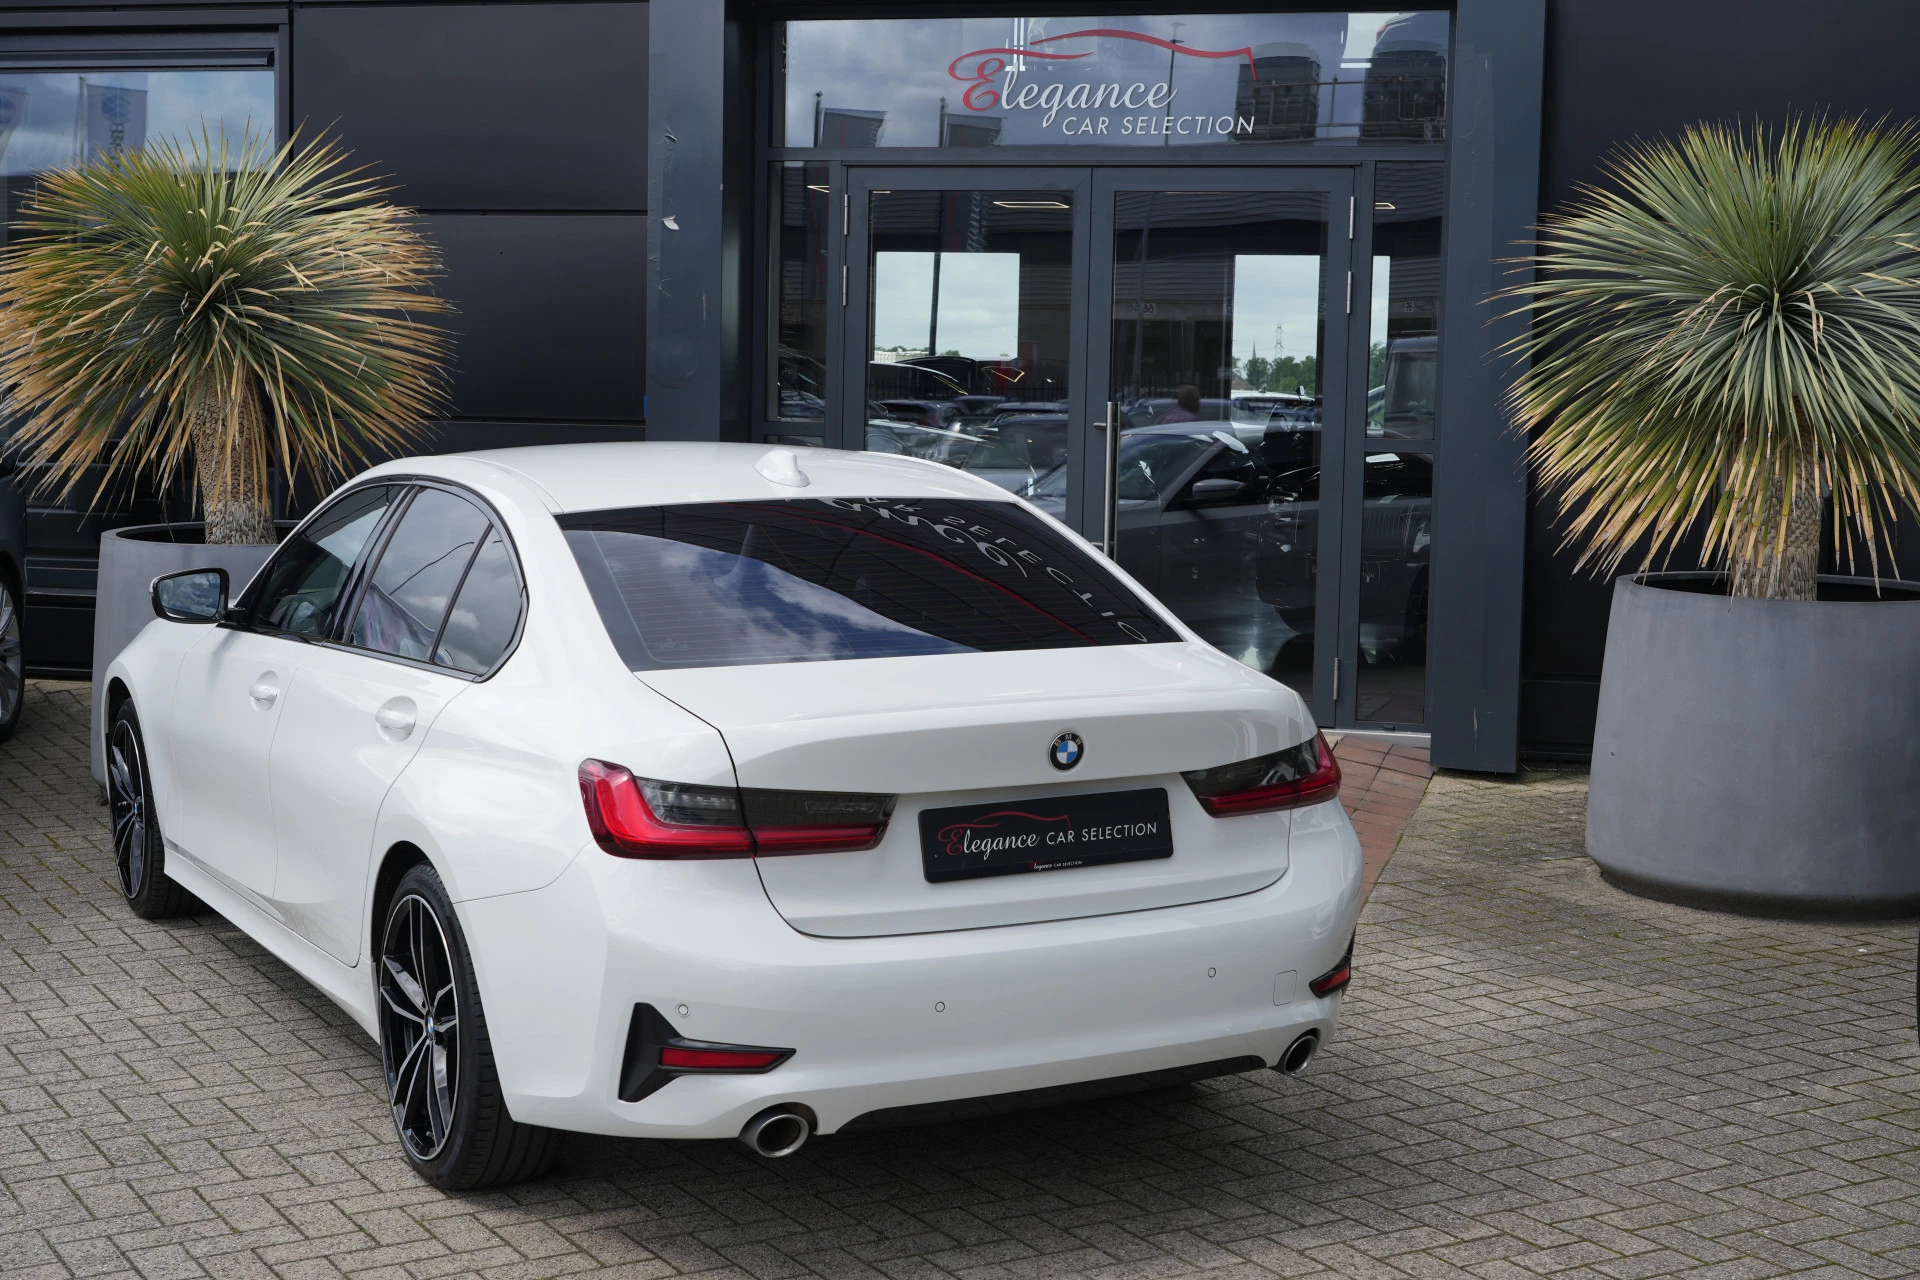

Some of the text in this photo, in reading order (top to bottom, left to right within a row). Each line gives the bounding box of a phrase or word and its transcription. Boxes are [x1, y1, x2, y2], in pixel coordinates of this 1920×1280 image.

[948, 47, 1178, 128] Elegance
[1062, 115, 1256, 135] CAR SELECTION
[1053, 733, 1082, 747] BMW
[938, 822, 1157, 861] Elegance CAR SELECTION
